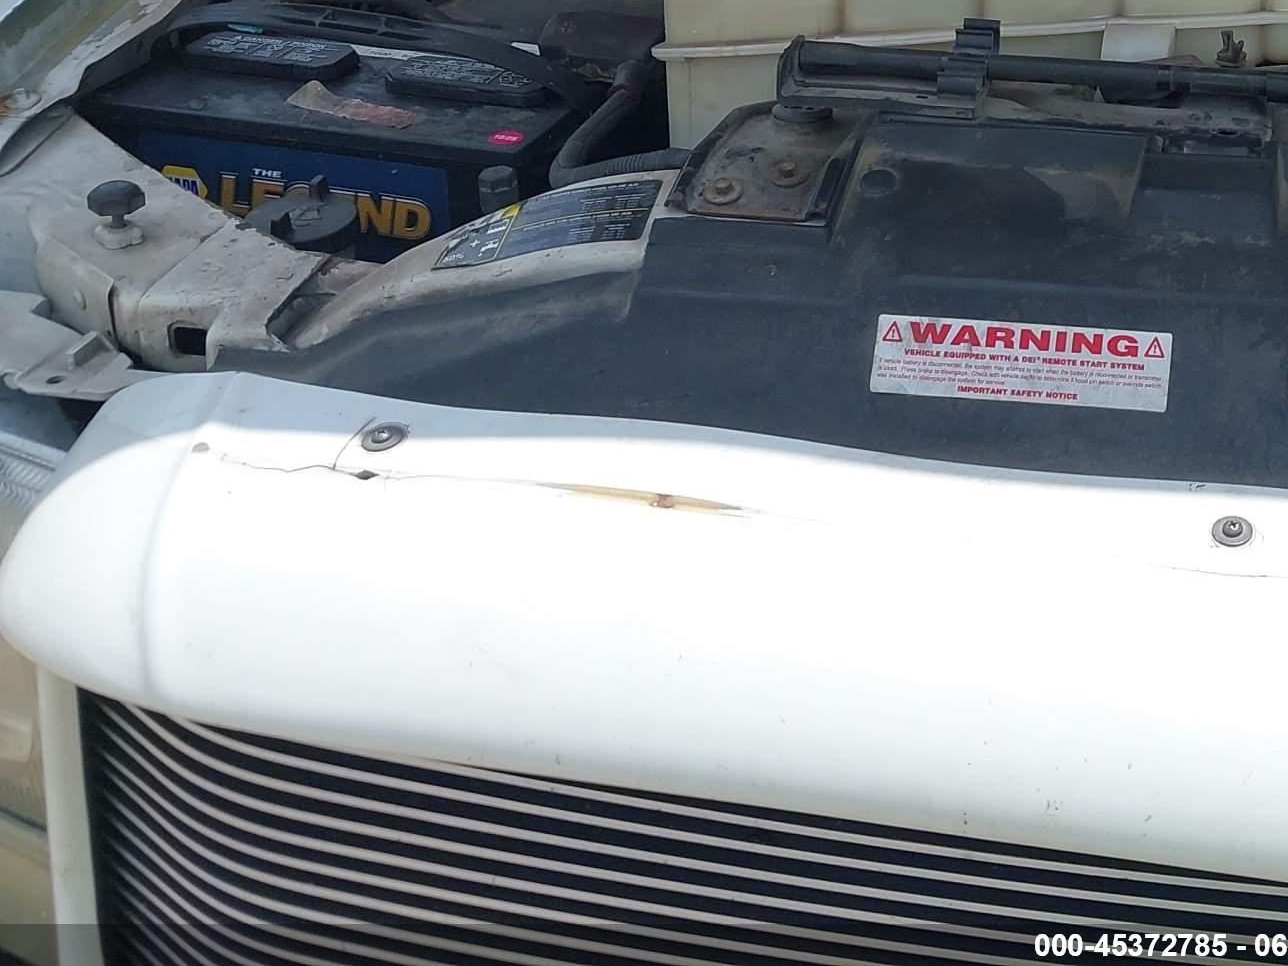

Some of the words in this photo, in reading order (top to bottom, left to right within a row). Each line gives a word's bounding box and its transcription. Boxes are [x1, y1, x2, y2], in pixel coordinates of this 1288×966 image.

[252, 167, 283, 178] THE
[219, 171, 432, 240] LEND
[909, 321, 1140, 356] WARNING
[903, 348, 941, 357] VEHICLE
[943, 350, 986, 360] EQUIPPED
[988, 353, 1011, 361] WITH
[1041, 357, 1077, 366] REMOTE
[1079, 359, 1108, 368] START
[1110, 361, 1144, 370] SYSTEM
[957, 385, 1008, 395] IMPORTANT
[1010, 389, 1043, 397] SAFETY
[1045, 391, 1078, 399] NOTICE
